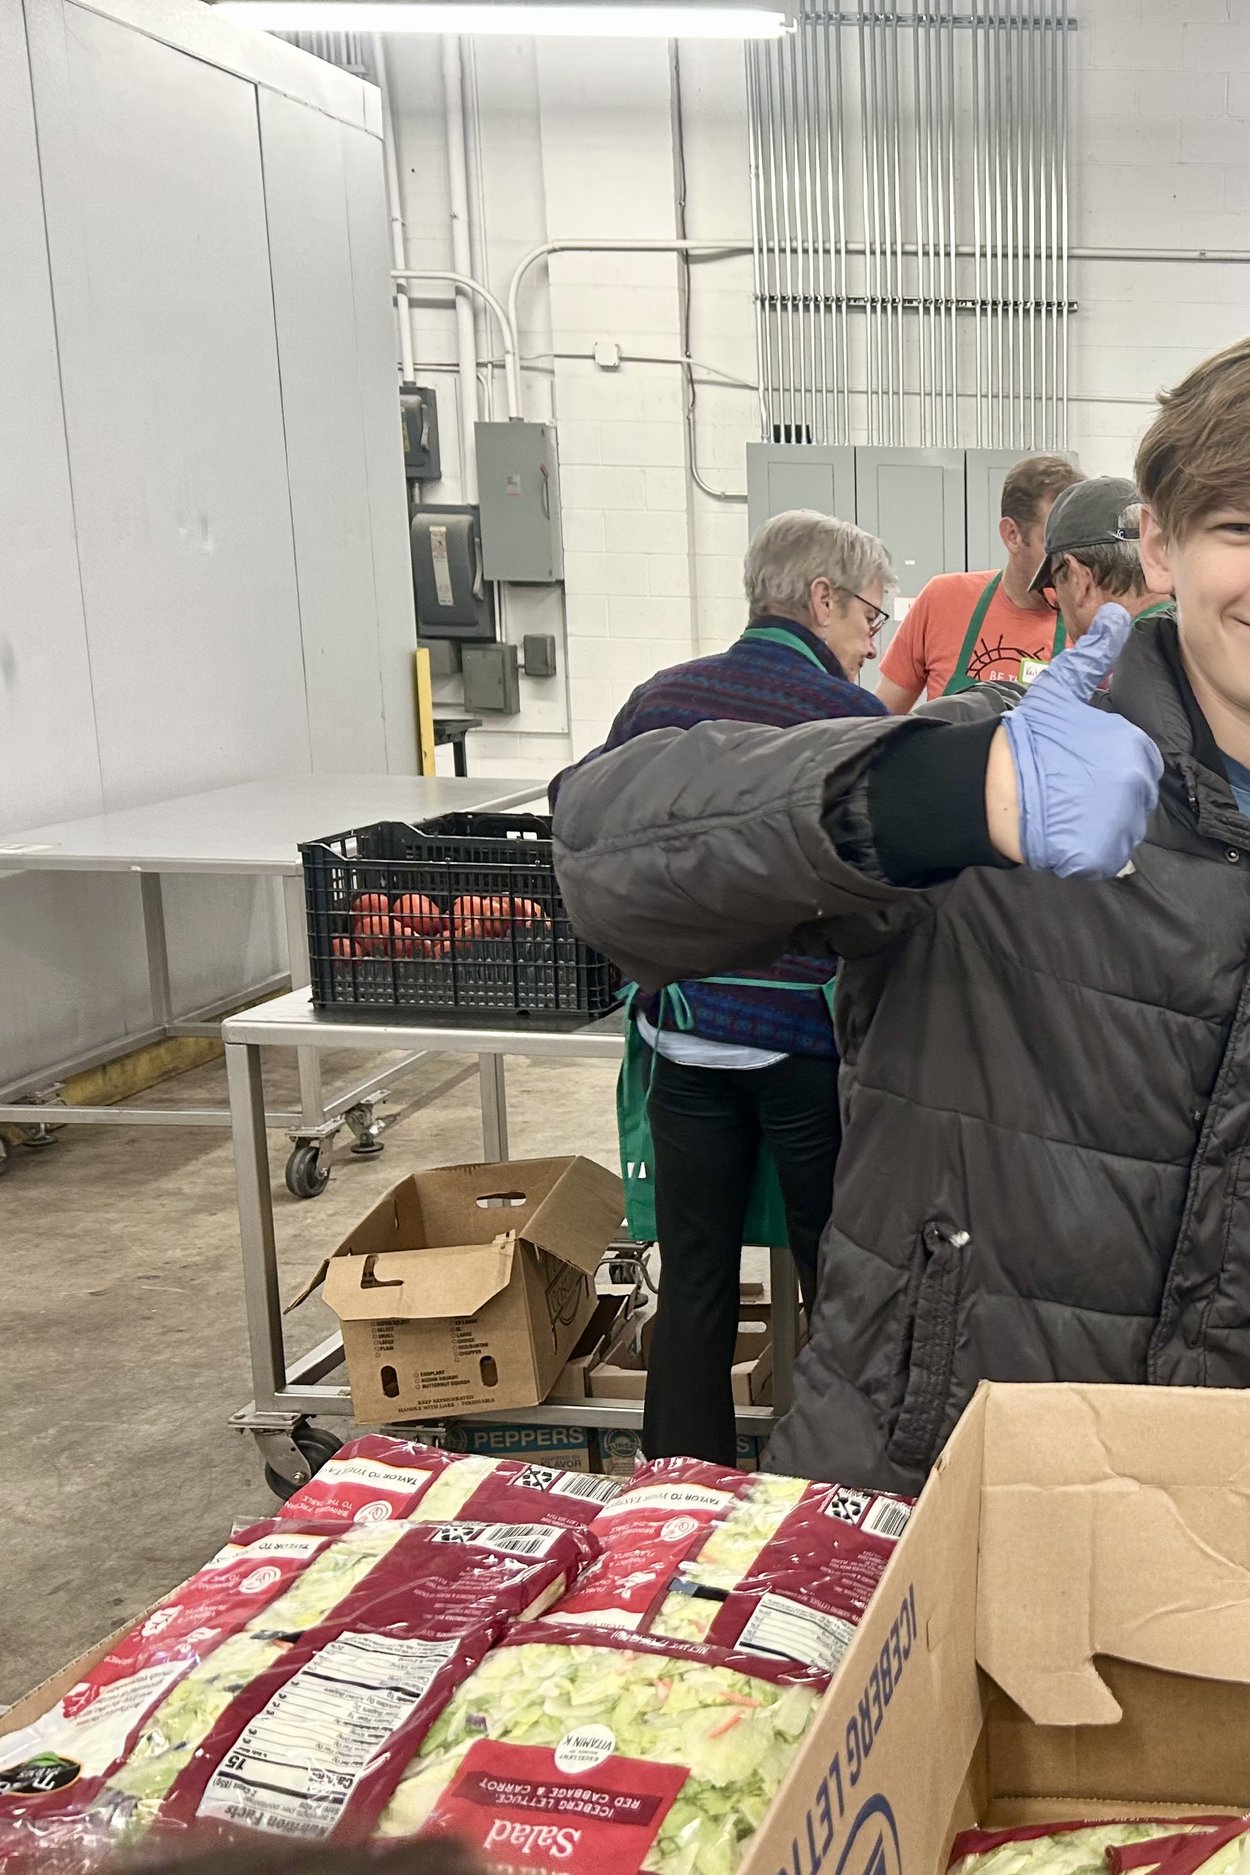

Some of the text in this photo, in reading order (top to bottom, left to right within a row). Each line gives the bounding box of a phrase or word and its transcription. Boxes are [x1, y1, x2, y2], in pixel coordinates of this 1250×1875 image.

[474, 1427, 584, 1448] PEPPERS
[368, 1470, 382, 1479] TO
[382, 1473, 418, 1486] TAYLOR
[670, 1492, 683, 1501] TO
[686, 1493, 720, 1506] TAYLOR
[846, 1583, 917, 1787] ICEBERG
[563, 1735, 612, 1751] VITAMIN K
[225, 1755, 247, 1772] 15
[479, 1778, 641, 1810] RED CABBAGE & CARROT
[223, 1804, 264, 1826] Facts
[558, 1798, 615, 1818] ICEBERG
[777, 1751, 844, 1875] LETT
[483, 1819, 581, 1858] Salad
